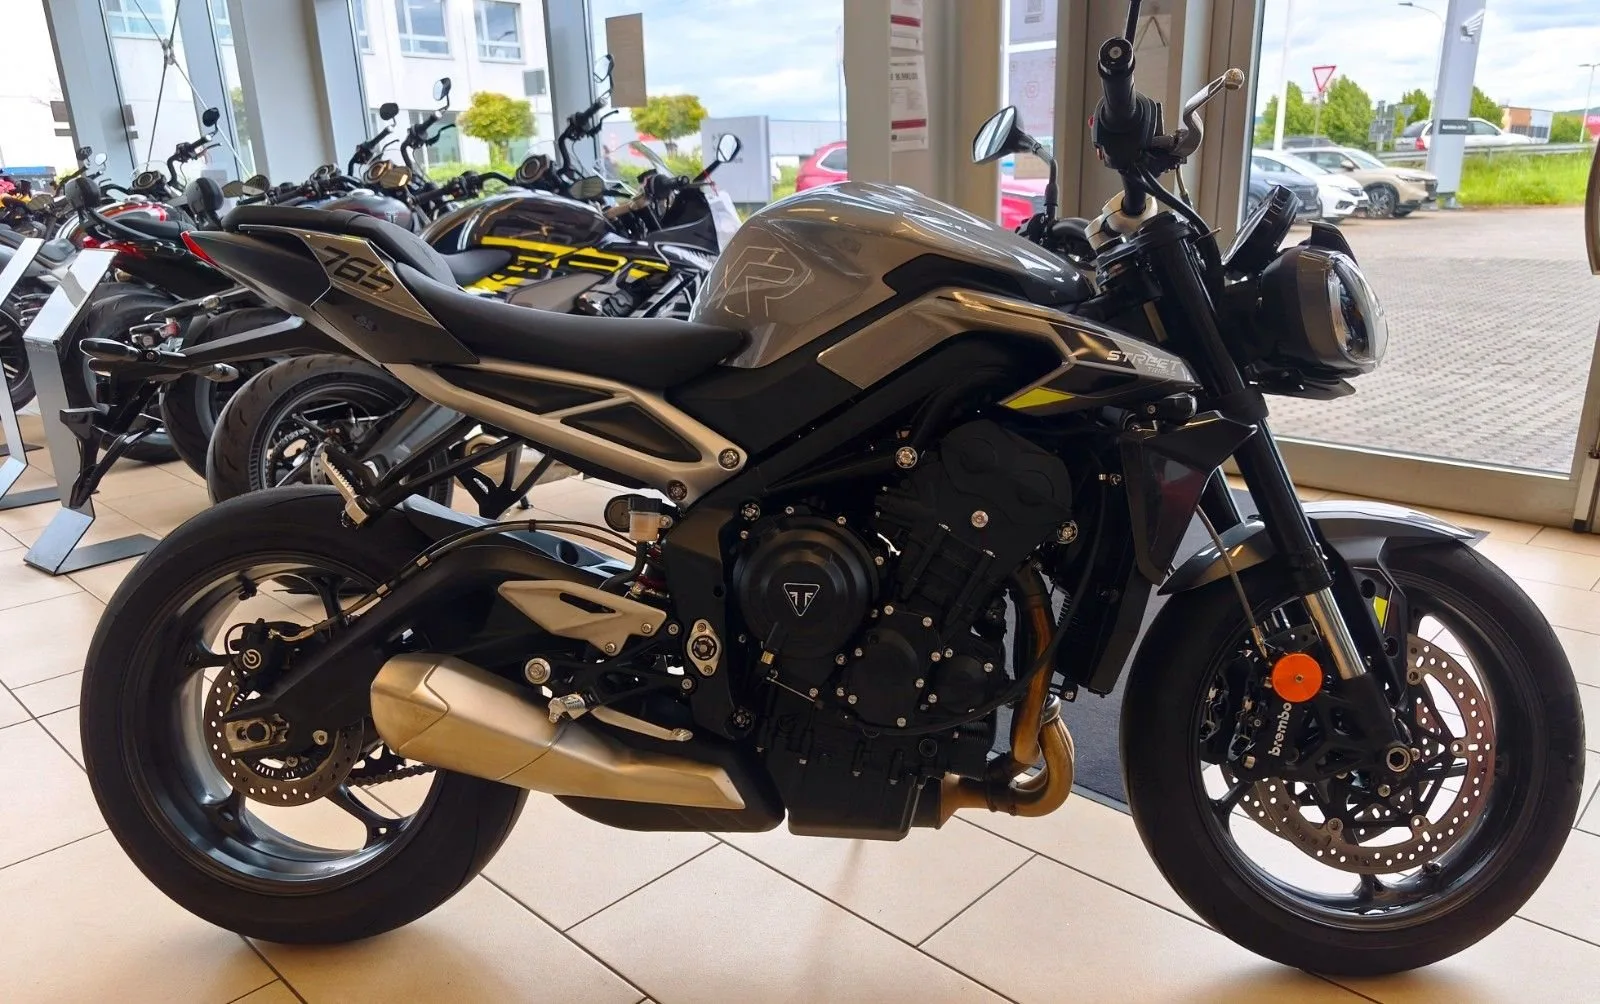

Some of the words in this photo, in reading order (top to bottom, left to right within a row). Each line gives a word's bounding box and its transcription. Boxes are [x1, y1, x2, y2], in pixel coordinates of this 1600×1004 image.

[322, 245, 394, 295] 765
[1106, 350, 1182, 370] STREET
[1268, 702, 1292, 757] brembo
